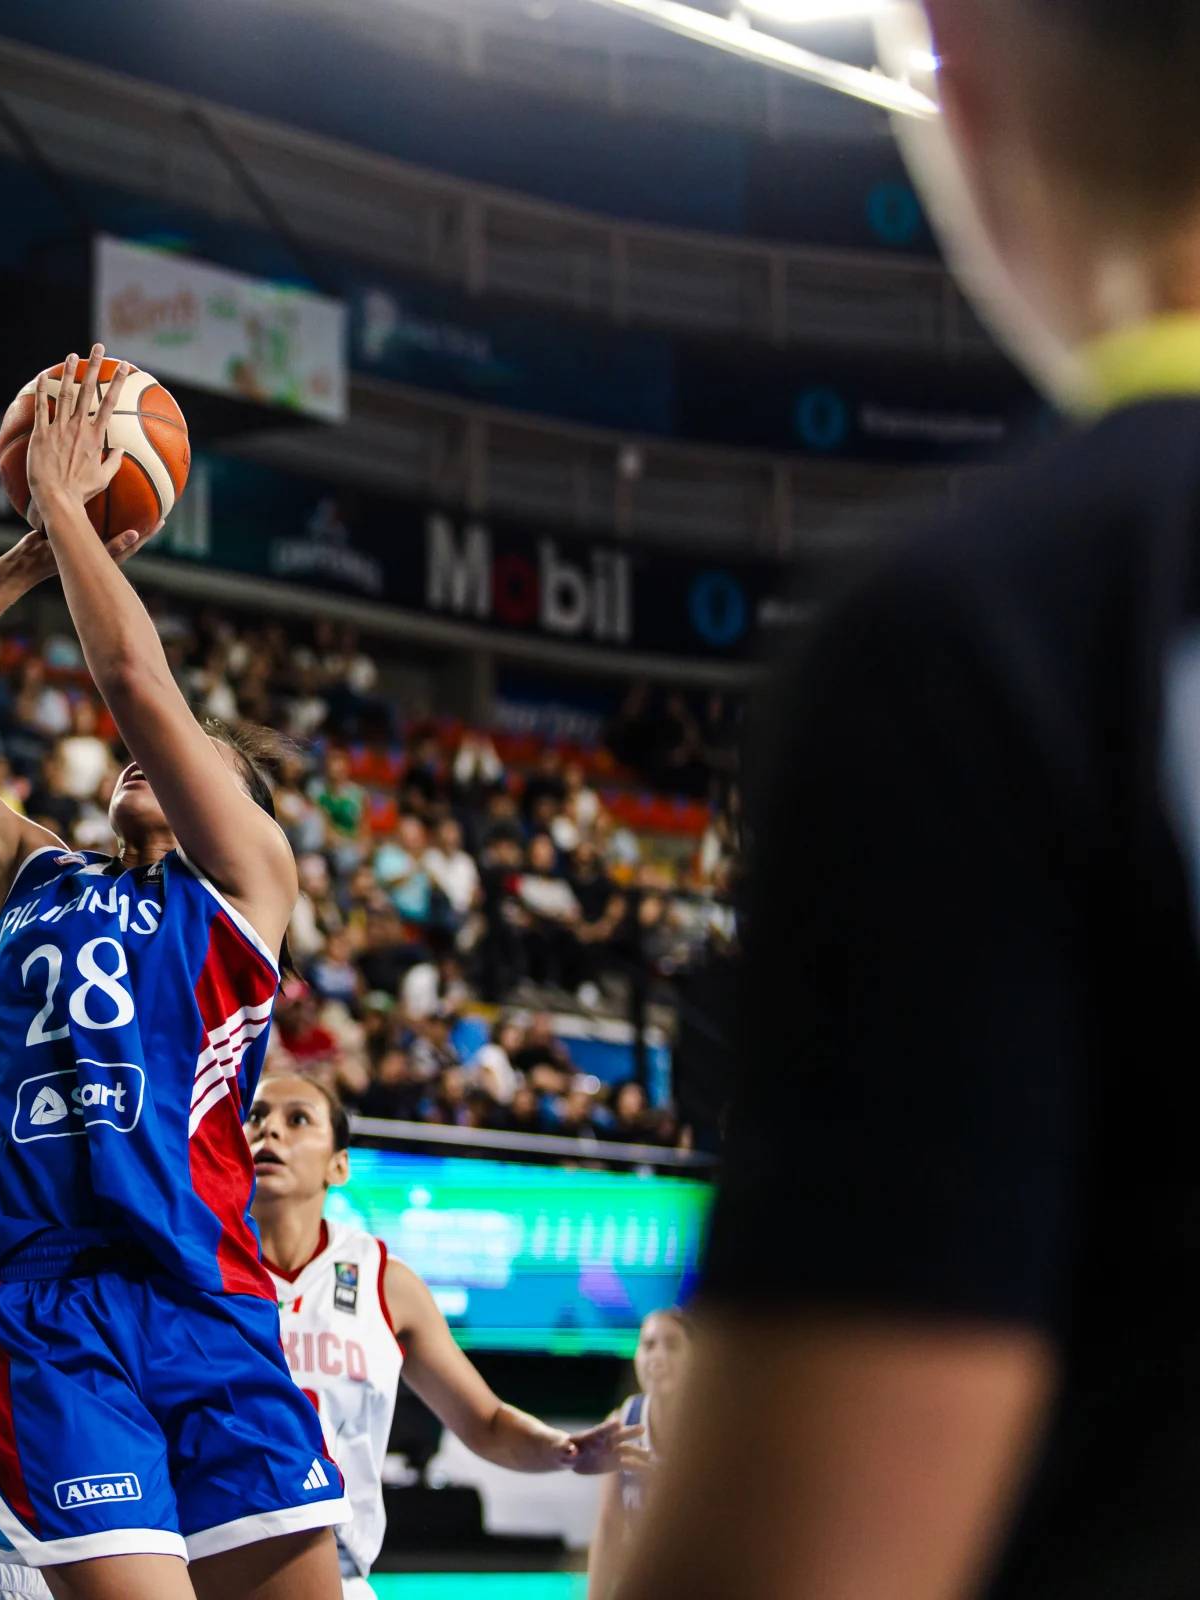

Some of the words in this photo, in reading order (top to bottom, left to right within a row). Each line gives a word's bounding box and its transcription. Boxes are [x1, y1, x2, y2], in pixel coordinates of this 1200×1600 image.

[426, 515, 632, 635] Mobil
[21, 937, 135, 1047] 28
[71, 1082, 127, 1116] sart
[281, 1331, 369, 1382] XICO
[65, 1477, 135, 1505] Akari
